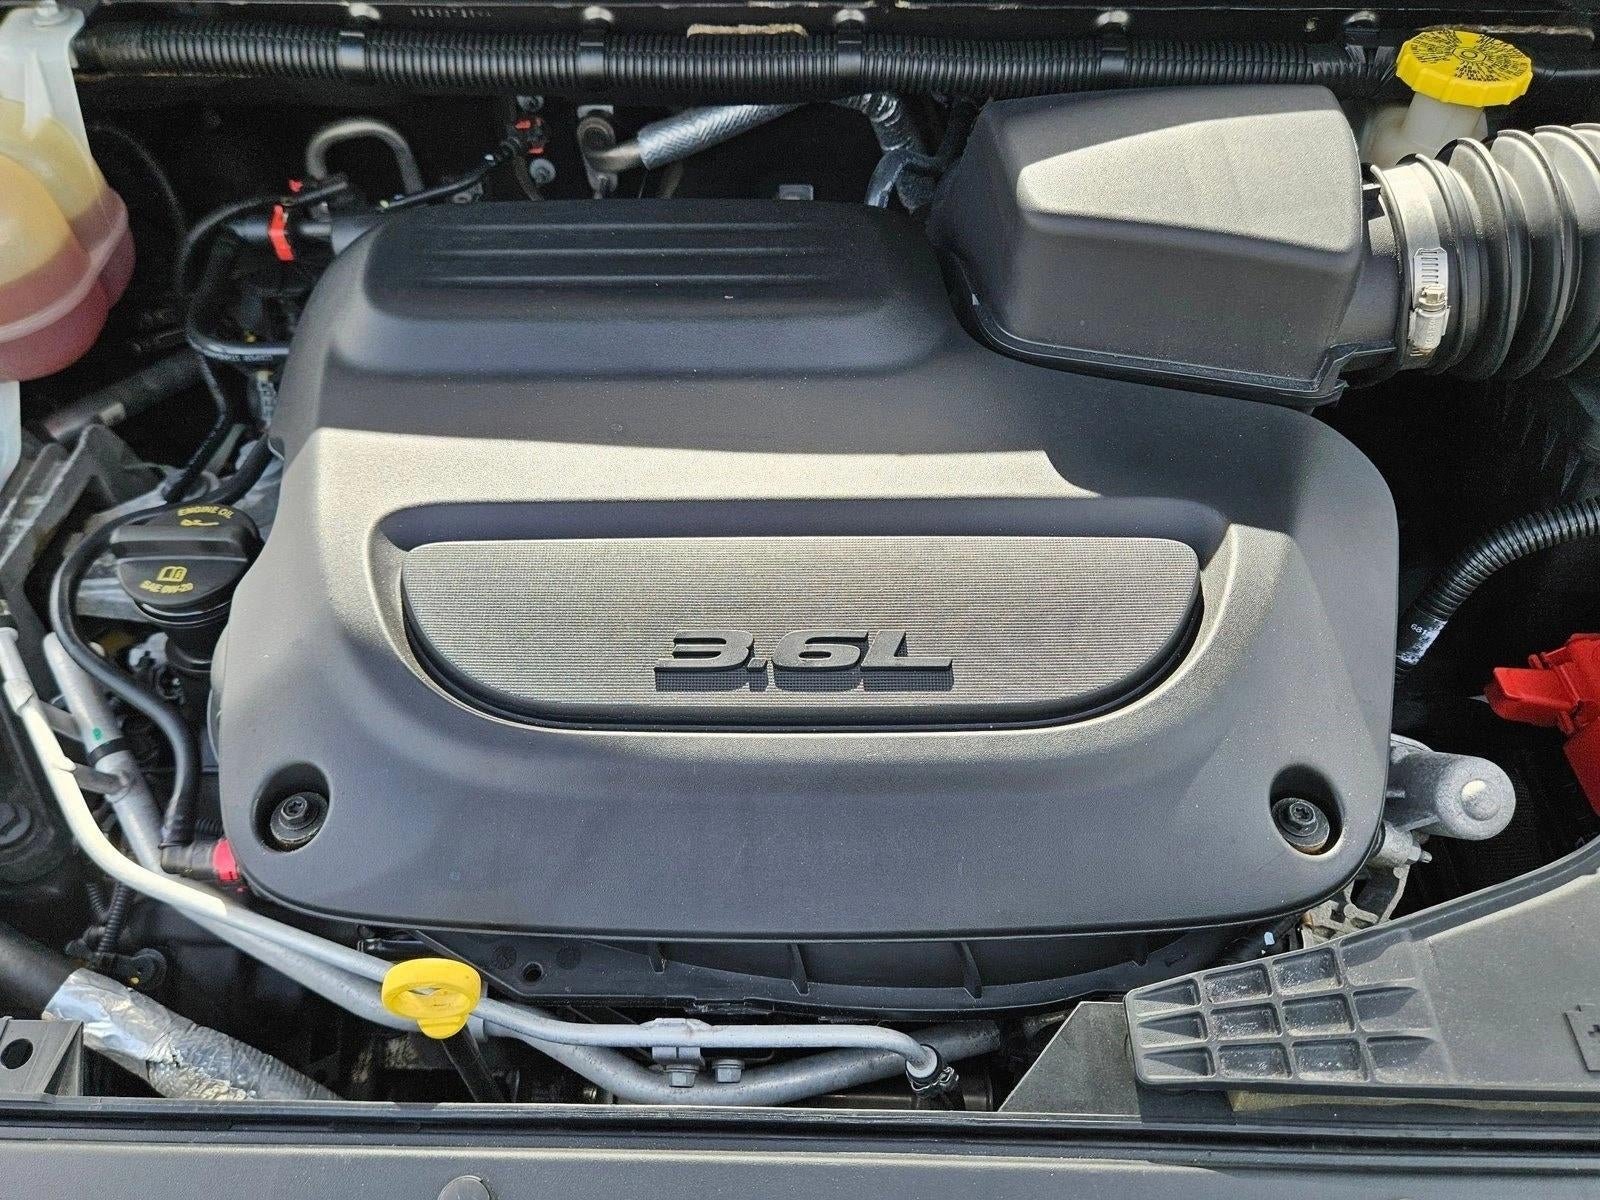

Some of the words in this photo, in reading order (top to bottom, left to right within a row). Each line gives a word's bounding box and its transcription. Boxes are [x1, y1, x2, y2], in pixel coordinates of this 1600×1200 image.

[177, 506, 220, 516] ENGINE
[217, 508, 235, 519] OIL
[140, 580, 163, 593] SAE
[653, 629, 953, 673] 3.6L
